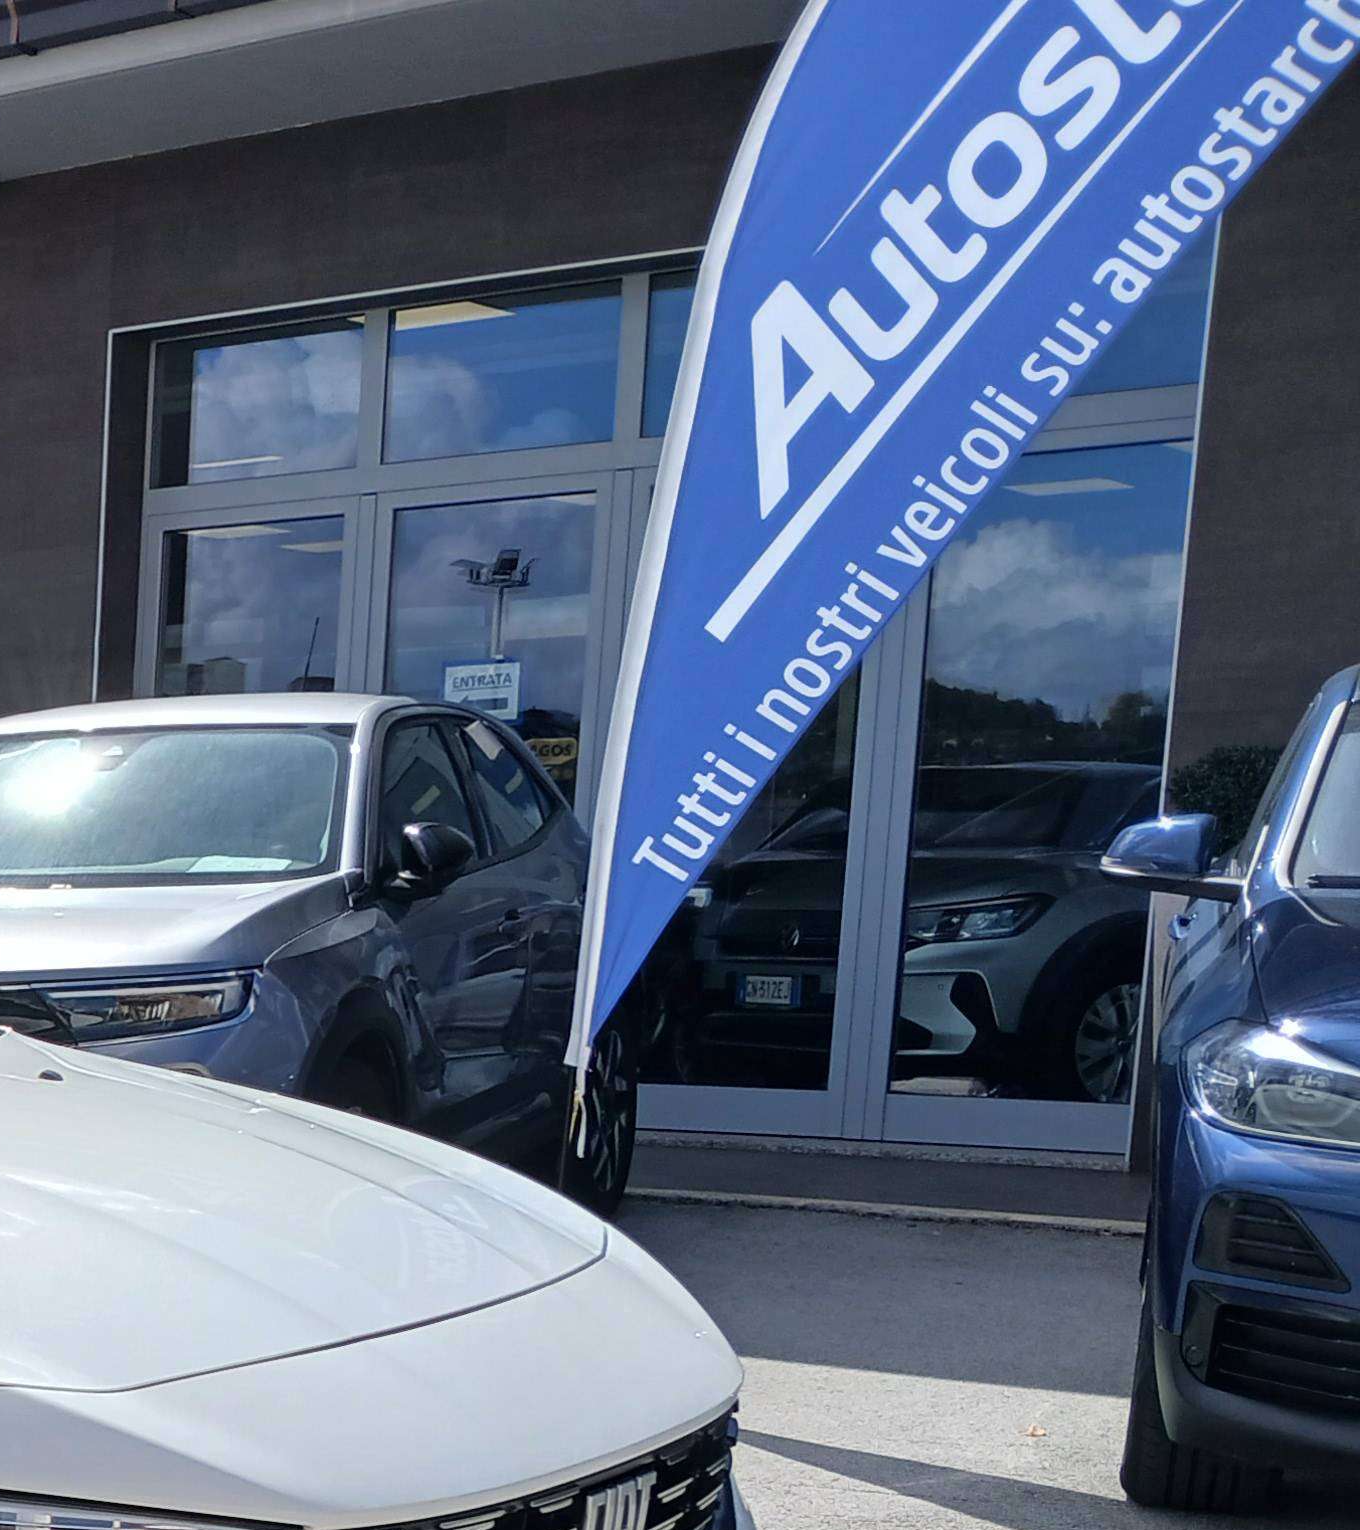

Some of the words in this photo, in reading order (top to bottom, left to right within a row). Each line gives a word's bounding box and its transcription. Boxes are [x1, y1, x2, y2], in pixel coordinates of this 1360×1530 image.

[751, 0, 1206, 520] Autost
[452, 673, 512, 689] ENTRATA
[632, 751, 757, 882] Tutti
[723, 723, 777, 761] i
[755, 562, 900, 733] nostri
[876, 385, 1038, 568] veicoli
[1021, 302, 1113, 397] su:
